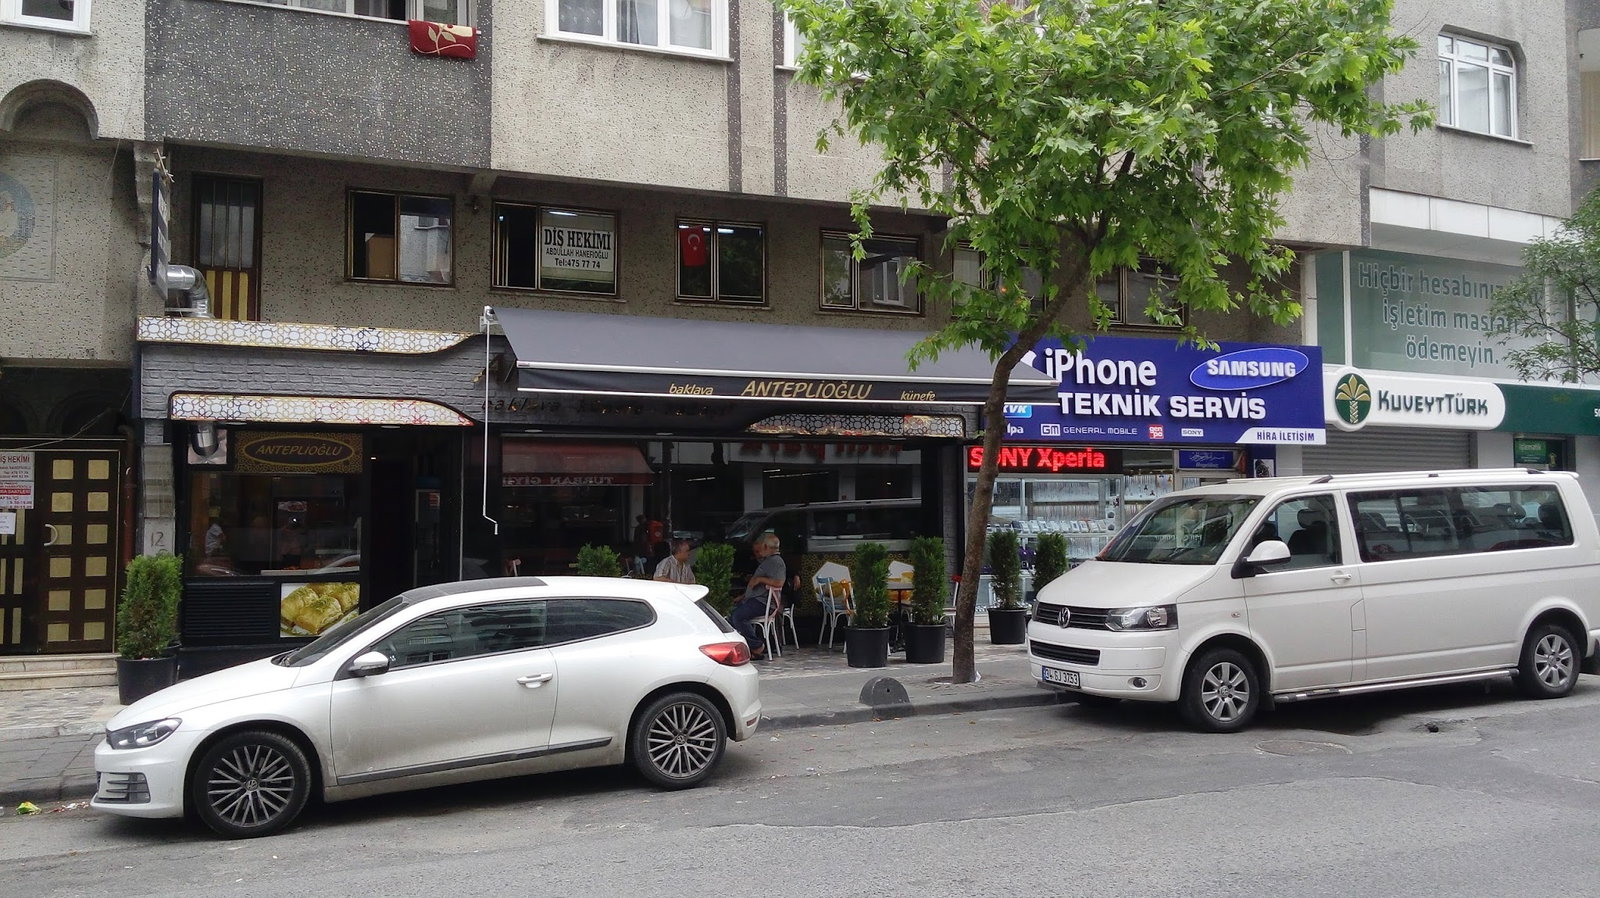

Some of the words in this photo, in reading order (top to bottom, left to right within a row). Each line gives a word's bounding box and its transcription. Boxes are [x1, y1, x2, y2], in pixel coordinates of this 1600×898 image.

[567, 230, 611, 250] HEKİMİ
[546, 247, 574, 257] ABDULLAH
[582, 260, 590, 268] 77
[592, 261, 601, 269] 74
[1359, 262, 1414, 296] Hiçbir
[1382, 298, 1447, 330] işletim
[1406, 335, 1499, 368] ödemeyin.
[1045, 347, 1157, 386] iPhone
[1207, 359, 1296, 377] SAMSUNG
[669, 383, 714, 396] baklava
[741, 380, 872, 400] ANTEPLİOĞLU
[900, 390, 936, 401] künefe
[1058, 388, 1162, 417] TEKNİK
[1170, 392, 1267, 419] SERVİS
[1043, 426, 1059, 434] GM
[1063, 426, 1105, 434] GENERAL
[1279, 431, 1315, 442] İLETİŞİM
[969, 447, 1035, 467] SNY
[1038, 448, 1105, 471] Xperia
[151, 531, 165, 547] 12
